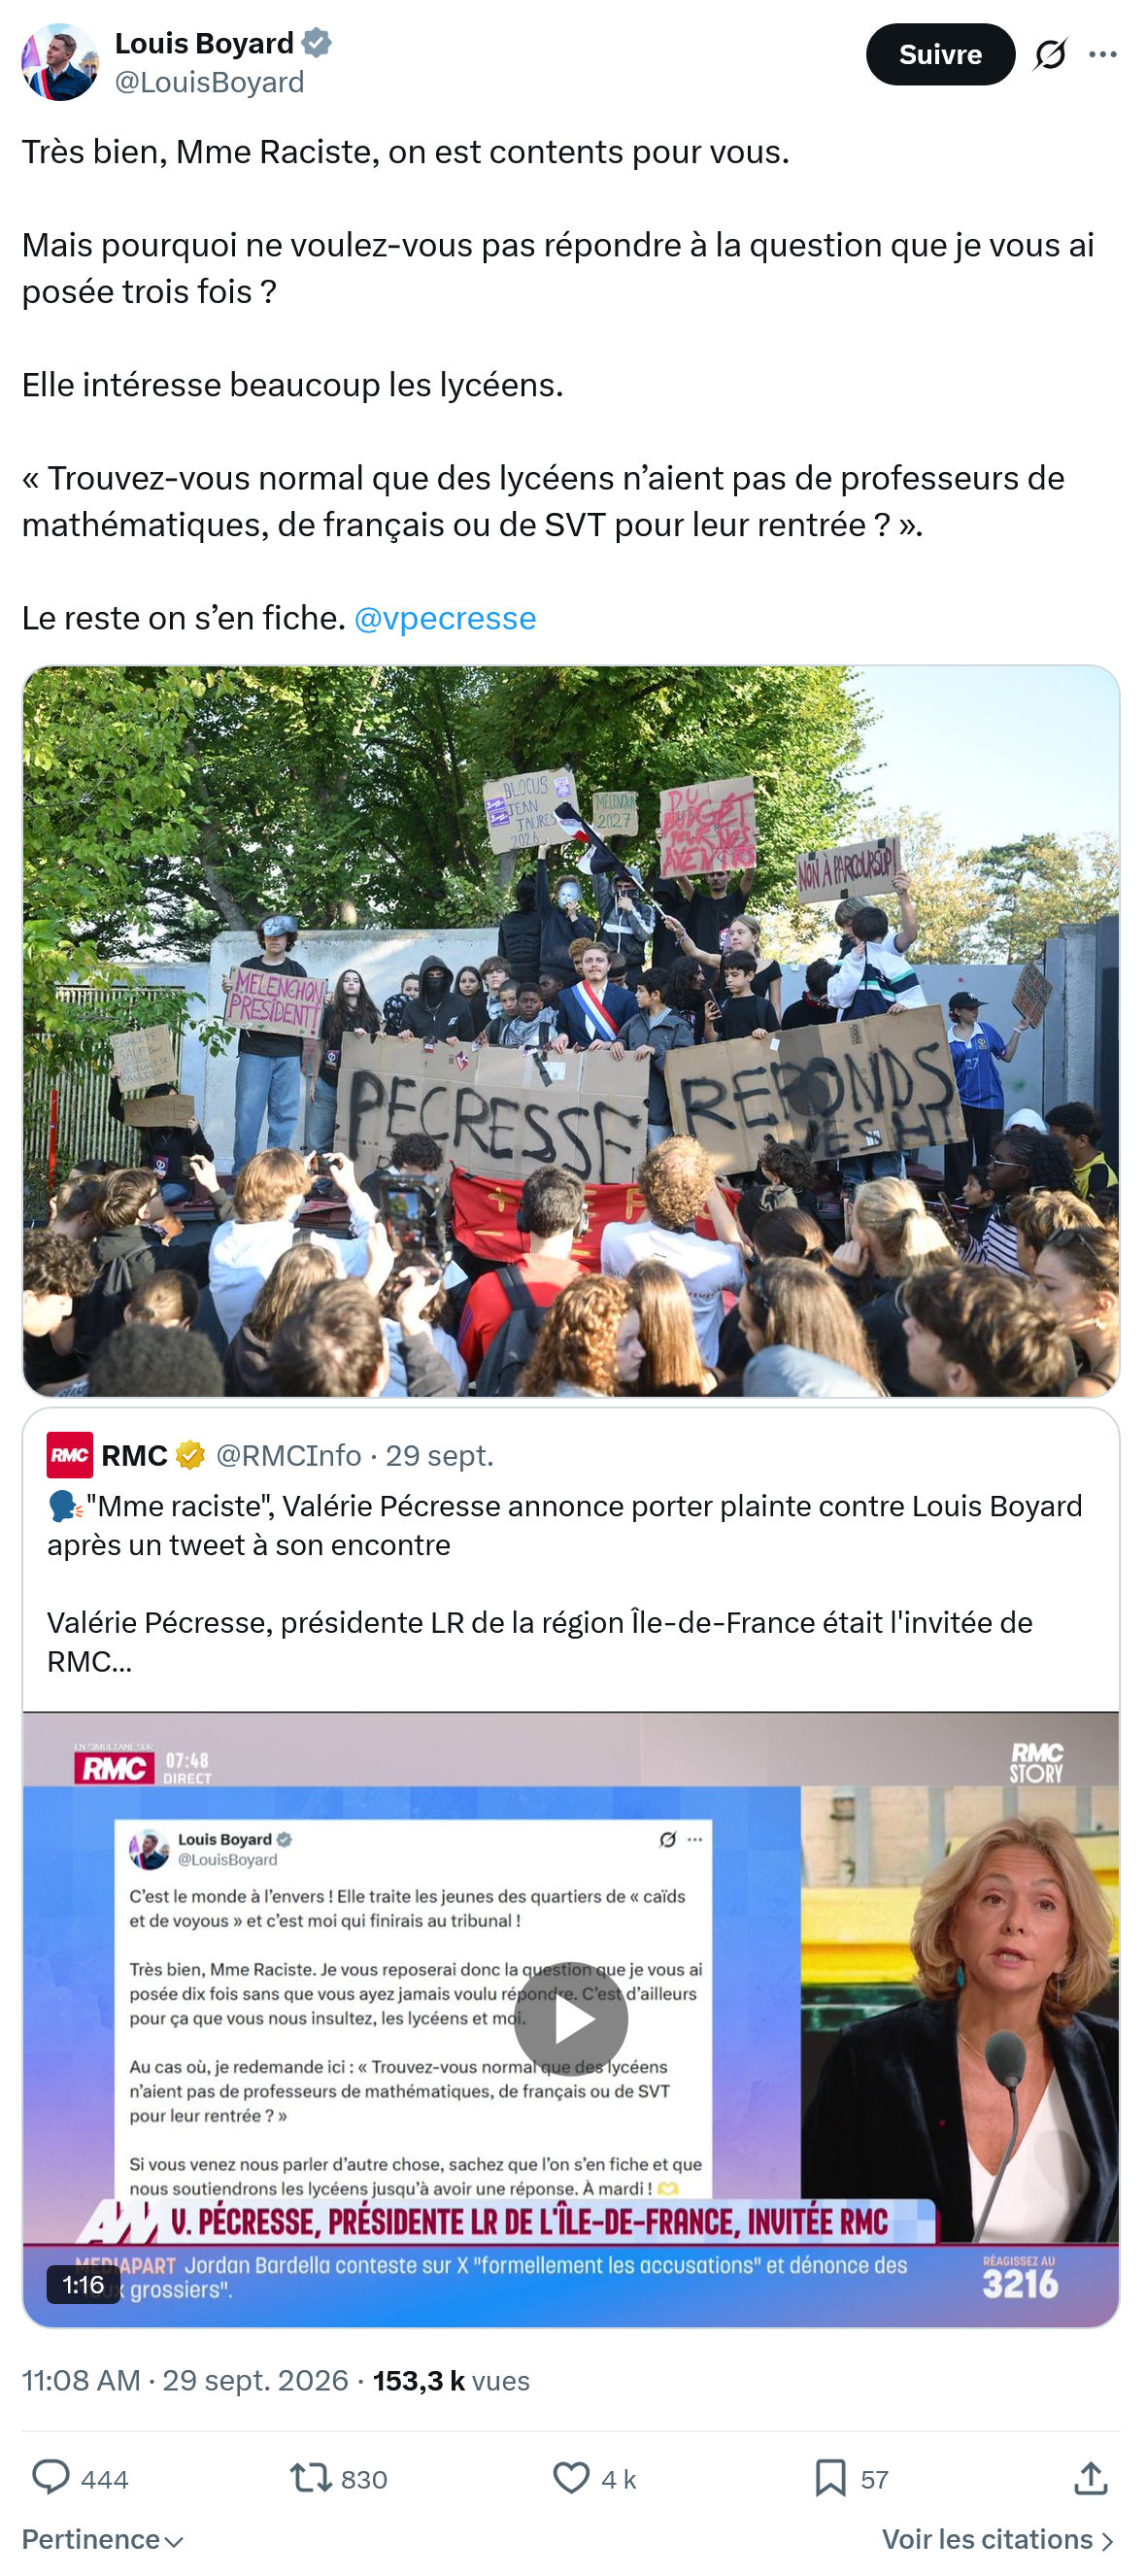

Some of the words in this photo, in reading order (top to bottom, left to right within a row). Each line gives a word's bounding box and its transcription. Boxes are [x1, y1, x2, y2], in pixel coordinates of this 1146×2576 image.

[116, 30, 189, 54] Louis
[196, 30, 294, 60] Boyard
[898, 42, 983, 65] Suivre
[116, 69, 304, 99] @LouisBoyard
[20, 136, 84, 164] Très
[94, 137, 167, 169] bien,
[177, 139, 252, 164] Mme
[260, 138, 380, 169] Raciste,
[388, 145, 425, 164] on
[435, 140, 482, 164] est
[489, 140, 624, 164] contents
[633, 145, 703, 171] pour
[709, 145, 790, 164] vous.
[23, 370, 75, 397] Elle
[84, 369, 221, 397] intéresse
[230, 370, 381, 404] beaucoup
[389, 370, 431, 397] les
[441, 369, 563, 404] lycéens.
[23, 605, 56, 630] Le
[65, 606, 141, 630] reste
[149, 611, 185, 630] on
[194, 603, 253, 630] s’en
[261, 603, 346, 630] fiche.
[354, 606, 537, 637] @vpecresse
[503, 775, 549, 799] BLOCUS
[507, 799, 539, 817] JEAN
[667, 788, 698, 812] DU
[597, 812, 631, 829] 2027
[798, 860, 820, 891] NON
[235, 969, 324, 1003] MELENCHON
[680, 1040, 955, 1138] REPONDS
[51, 1447, 89, 1463] RMC
[102, 1444, 168, 1467] RMC
[217, 1442, 362, 1468] @RMCInfo
[386, 1444, 421, 1467] 29
[427, 1444, 493, 1473] sept.
[86, 1493, 164, 1517] "Mme
[172, 1493, 275, 1521] raciste",
[282, 1493, 373, 1517] Valérie
[381, 1493, 501, 1517] Pécresse
[508, 1500, 624, 1517] annonce
[632, 1495, 714, 1523] porter
[721, 1493, 812, 1523] plainte
[819, 1495, 905, 1517] contre
[913, 1493, 982, 1517] Louis
[991, 1493, 1082, 1523] Boyard
[47, 1532, 121, 1562] après
[129, 1539, 161, 1556] un
[168, 1534, 246, 1556] tweet
[253, 1532, 268, 1556] à
[276, 1539, 323, 1556] son
[331, 1534, 451, 1556] encontre
[48, 1650, 132, 1673] RMC...
[166, 1752, 209, 1769] 07:48
[1011, 1743, 1064, 1763] RMC
[83, 1756, 147, 1780] RMC
[163, 1773, 212, 1784] DIRECT
[1009, 1764, 1063, 1783] STORY
[178, 1832, 218, 1847] Louis
[220, 1832, 273, 1849] Boyard
[178, 1852, 278, 1870] @LouisBoyard
[129, 1888, 170, 1904] C’est
[173, 1888, 188, 1904] le
[191, 1888, 248, 1904] monde
[251, 1888, 260, 1904] à
[264, 1888, 325, 1904] l’envers
[328, 1888, 333, 1904] !
[337, 1888, 366, 1904] Elle
[368, 1888, 412, 1904] traite
[415, 1888, 438, 1904] les
[440, 1888, 494, 1908] jeunes
[497, 1888, 527, 1904] des
[530, 1888, 602, 1907] quartiers
[605, 1888, 626, 1904] de
[629, 1892, 639, 1903] «
[643, 1888, 686, 1904] caïds
[129, 2185, 169, 2196] nous
[172, 2181, 278, 2196] soutiendrons
[281, 2181, 304, 2196] les
[308, 2181, 369, 2199] lycéens
[371, 2181, 429, 2199] jusqu’à
[433, 2181, 473, 2196] avoir
[476, 2185, 506, 2196] une
[510, 2181, 579, 2199] réponse.
[582, 2179, 595, 2196] À
[598, 2181, 644, 2196] mardi
[648, 2182, 653, 2196] !
[172, 2208, 192, 2235] V.
[199, 2199, 321, 2239] PÉCRESSE,
[329, 2200, 464, 2235] PRÉSIDENTE
[471, 2208, 498, 2235] LR
[505, 2208, 533, 2235] DE
[540, 2200, 741, 2239] L'ÎLE-DE-FRANCE,
[749, 2200, 833, 2235] INVITÉE
[840, 2208, 889, 2236] RMC
[185, 2255, 250, 2274] Jordan
[255, 2255, 330, 2274] Bardella
[335, 2258, 418, 2274] conteste
[422, 2259, 452, 2274] sur
[457, 2256, 468, 2274] X
[474, 2255, 603, 2274] "formellement
[609, 2255, 635, 2274] les
[640, 2255, 761, 2274] accusations"
[766, 2258, 785, 2274] et
[790, 2255, 869, 2274] dénonce
[874, 2255, 908, 2274] des
[983, 2253, 1039, 2267] RÉAGISSEZ
[1040, 2255, 1057, 2267] AU
[130, 2280, 232, 2303] grossiers".
[983, 2268, 1059, 2299] 3216
[21, 2369, 89, 2391] 11:08
[96, 2369, 140, 2391] AM
[163, 2369, 197, 2391] 29
[205, 2369, 270, 2397] sept.
[278, 2369, 349, 2391] 2026
[373, 2370, 444, 2395] 153,3
[451, 2369, 466, 2391] k
[471, 2375, 530, 2391] vues
[81, 2470, 129, 2490] 444
[341, 2470, 388, 2490] 830
[601, 2470, 618, 2490] 4
[624, 2468, 637, 2490] k
[860, 2470, 890, 2490] 57
[22, 2527, 160, 2550] Pertinence
[881, 2527, 933, 2550] Voir
[939, 2527, 975, 2550] les
[981, 2527, 1094, 2550] citations
